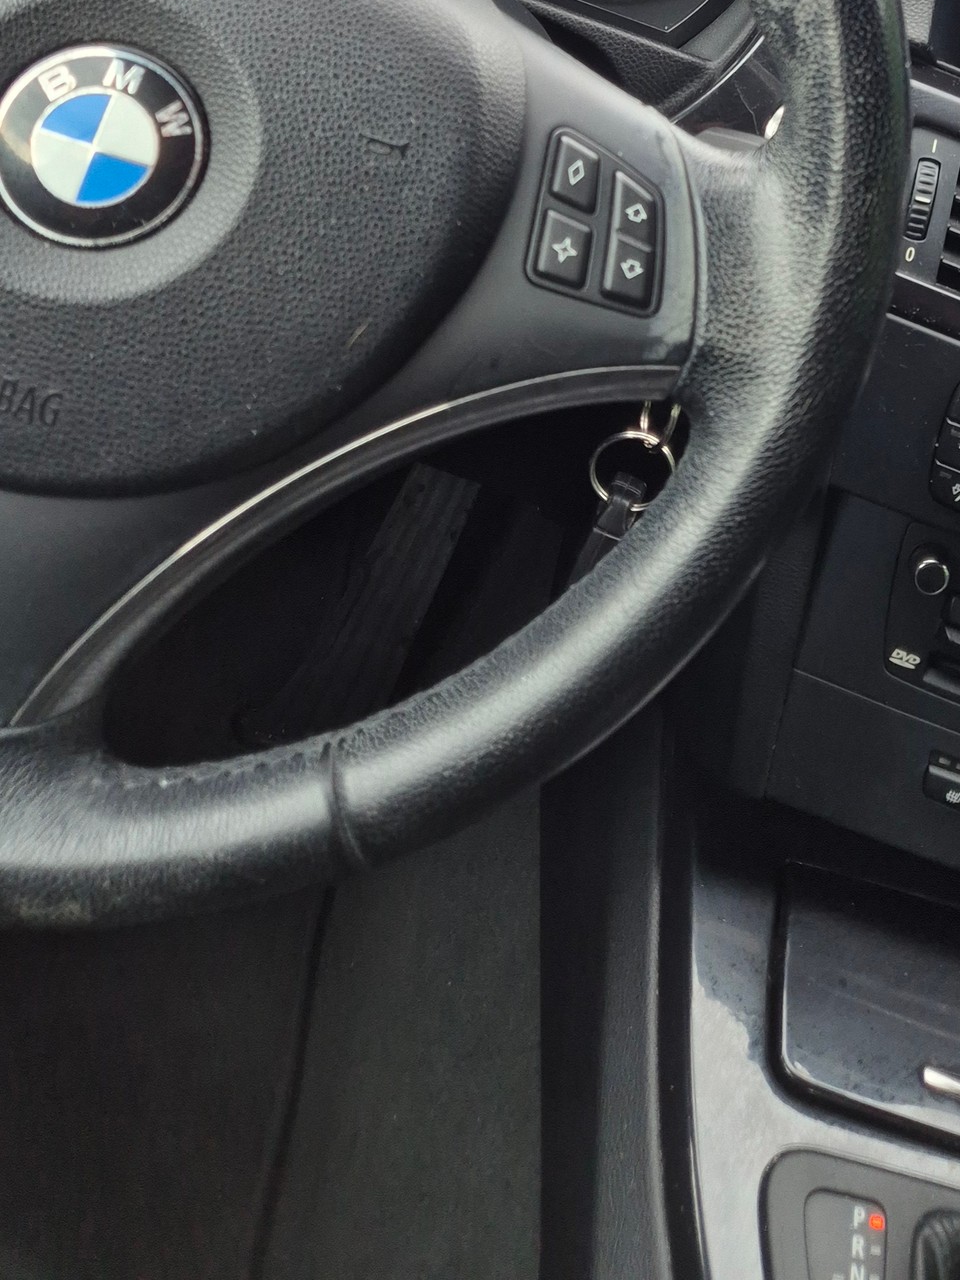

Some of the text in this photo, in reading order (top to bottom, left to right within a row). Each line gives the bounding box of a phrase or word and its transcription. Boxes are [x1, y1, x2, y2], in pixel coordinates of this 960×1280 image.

[37, 57, 193, 138] BMW
[904, 246, 916, 262] 0
[890, 647, 922, 668] DVD
[853, 1205, 865, 1230] P
[851, 1234, 865, 1260] R
